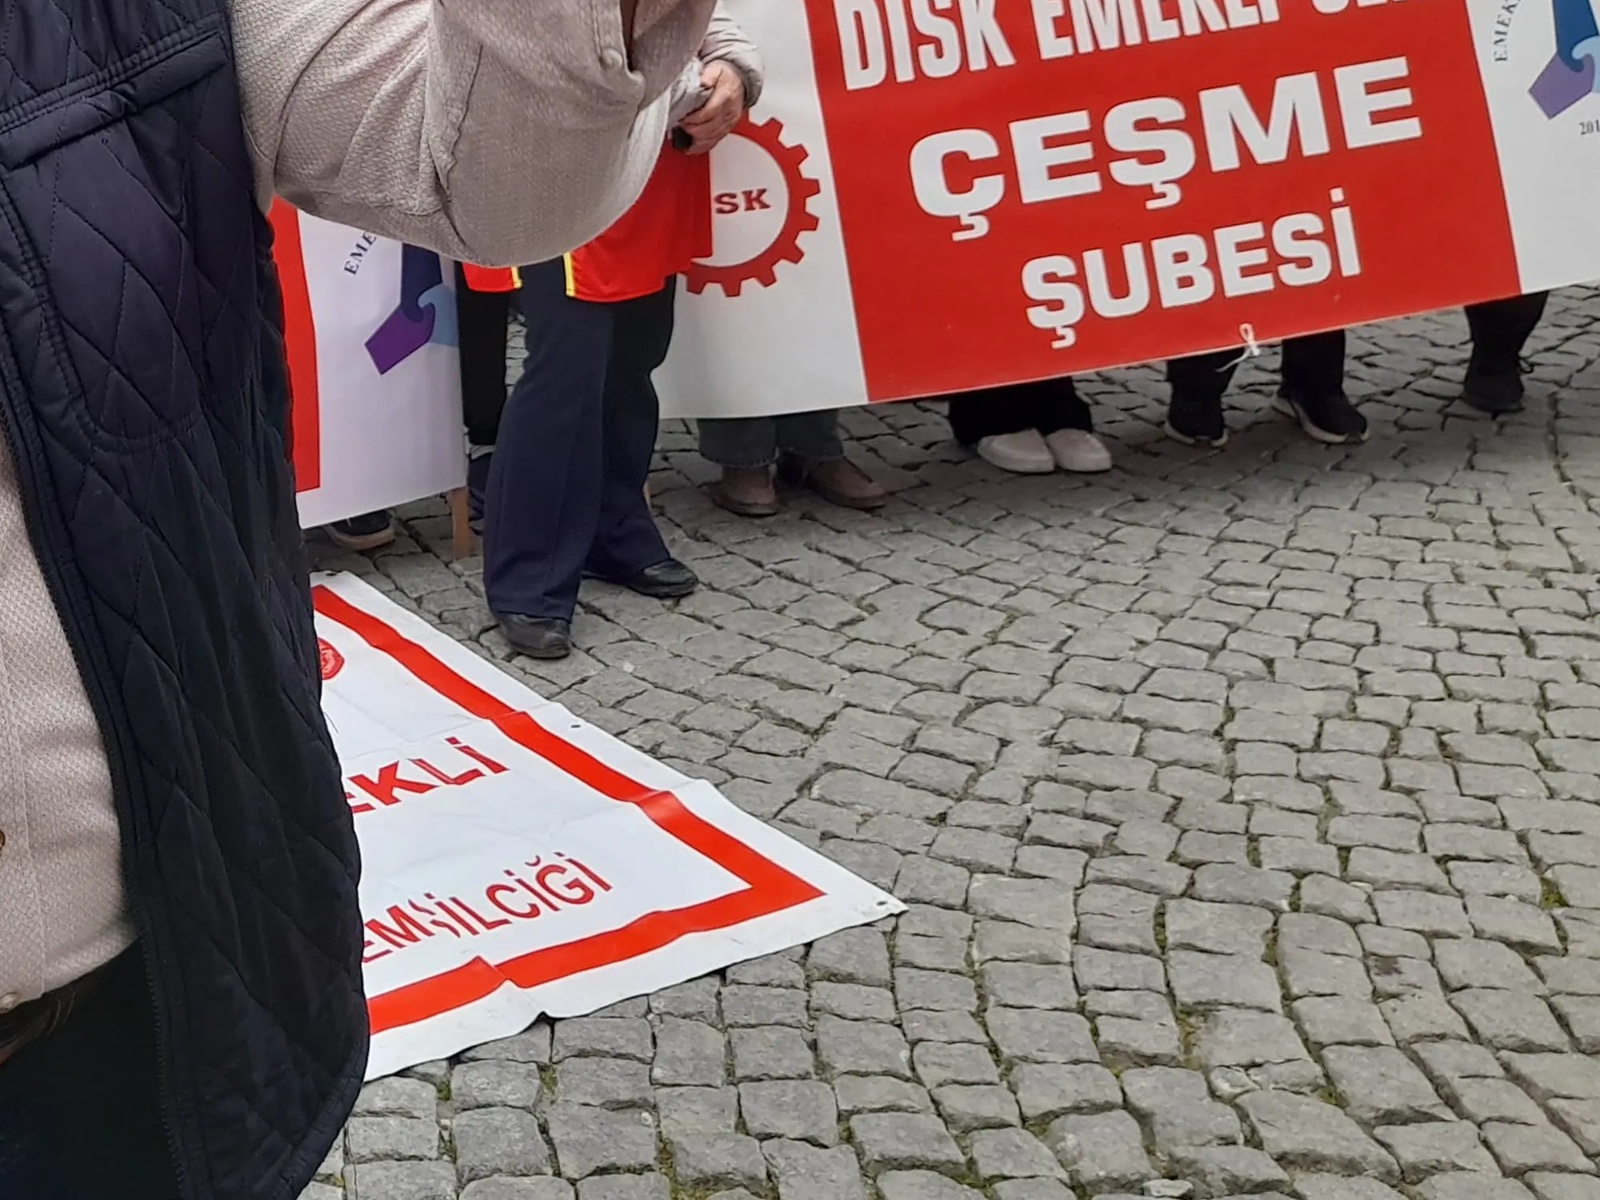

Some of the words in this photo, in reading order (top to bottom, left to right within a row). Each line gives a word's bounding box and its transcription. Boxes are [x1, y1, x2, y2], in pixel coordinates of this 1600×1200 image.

[909, 56, 1422, 241] ÇEŞME
[344, 231, 377, 275] EME
[713, 188, 771, 215] SK
[1021, 187, 1361, 350] ŞUBESİ
